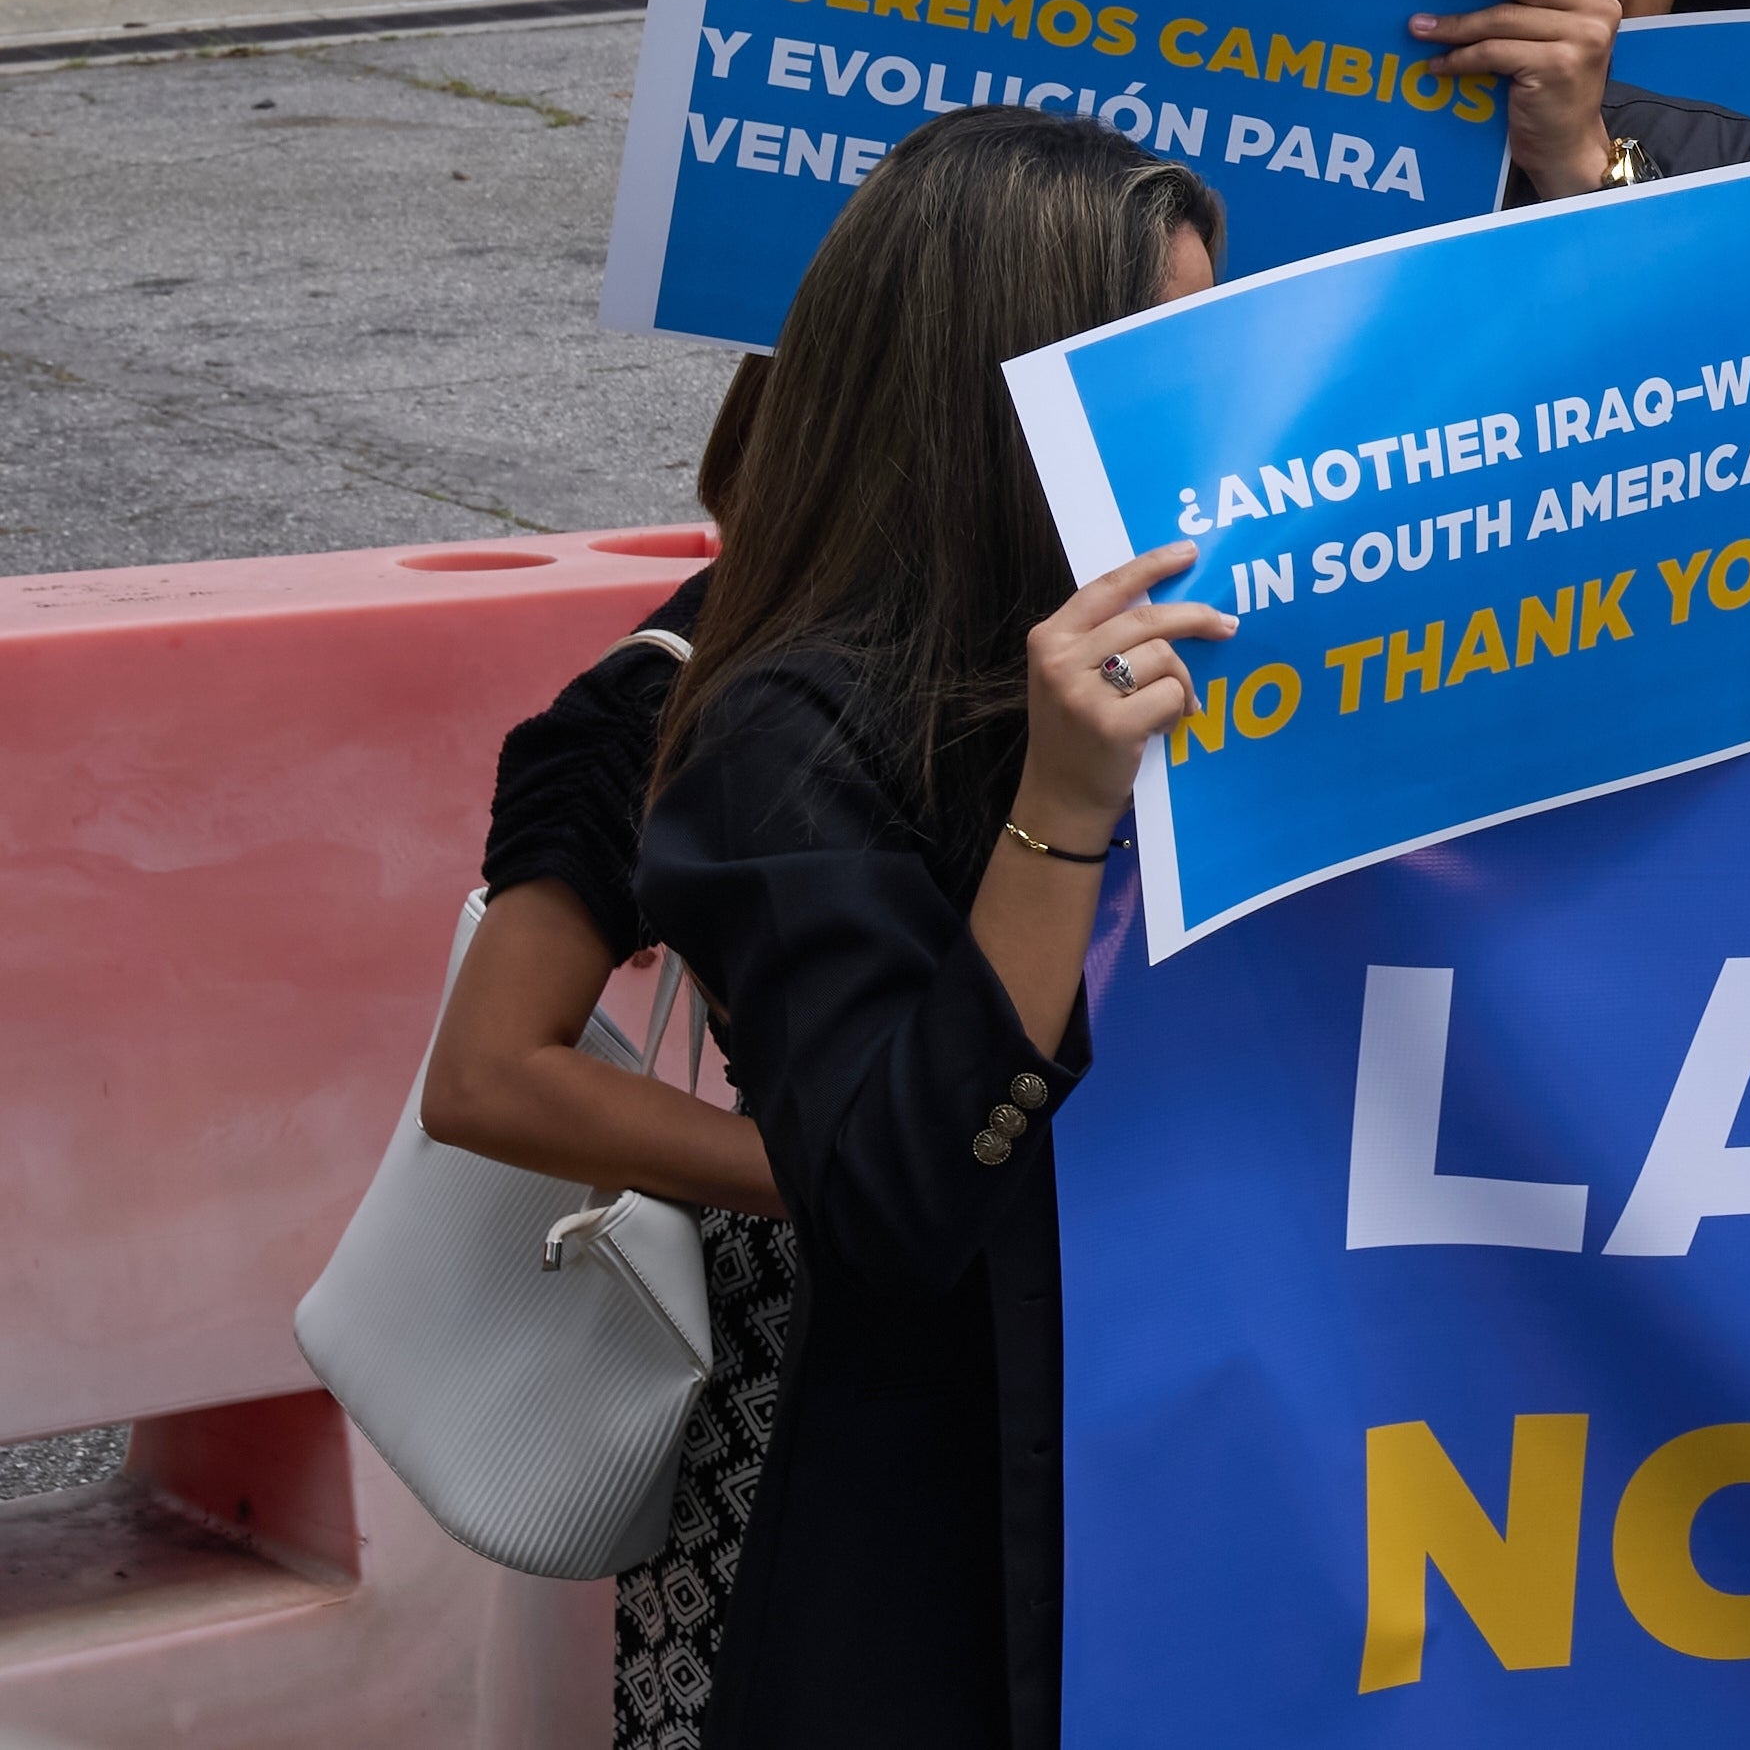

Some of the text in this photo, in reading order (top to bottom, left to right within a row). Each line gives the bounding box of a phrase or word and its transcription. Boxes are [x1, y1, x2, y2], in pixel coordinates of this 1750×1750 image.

[700, 27, 753, 78] Y
[1225, 125, 1425, 202] PARA
[1159, 17, 1498, 124] CAMBIOS
[686, 112, 898, 187] VENE
[1177, 413, 1519, 536] ¿ANOTHER
[1232, 558, 1294, 616] IN
[1312, 498, 1512, 596] SOUTH
[1171, 663, 1300, 766] NO
[1325, 570, 1637, 716] THANK
